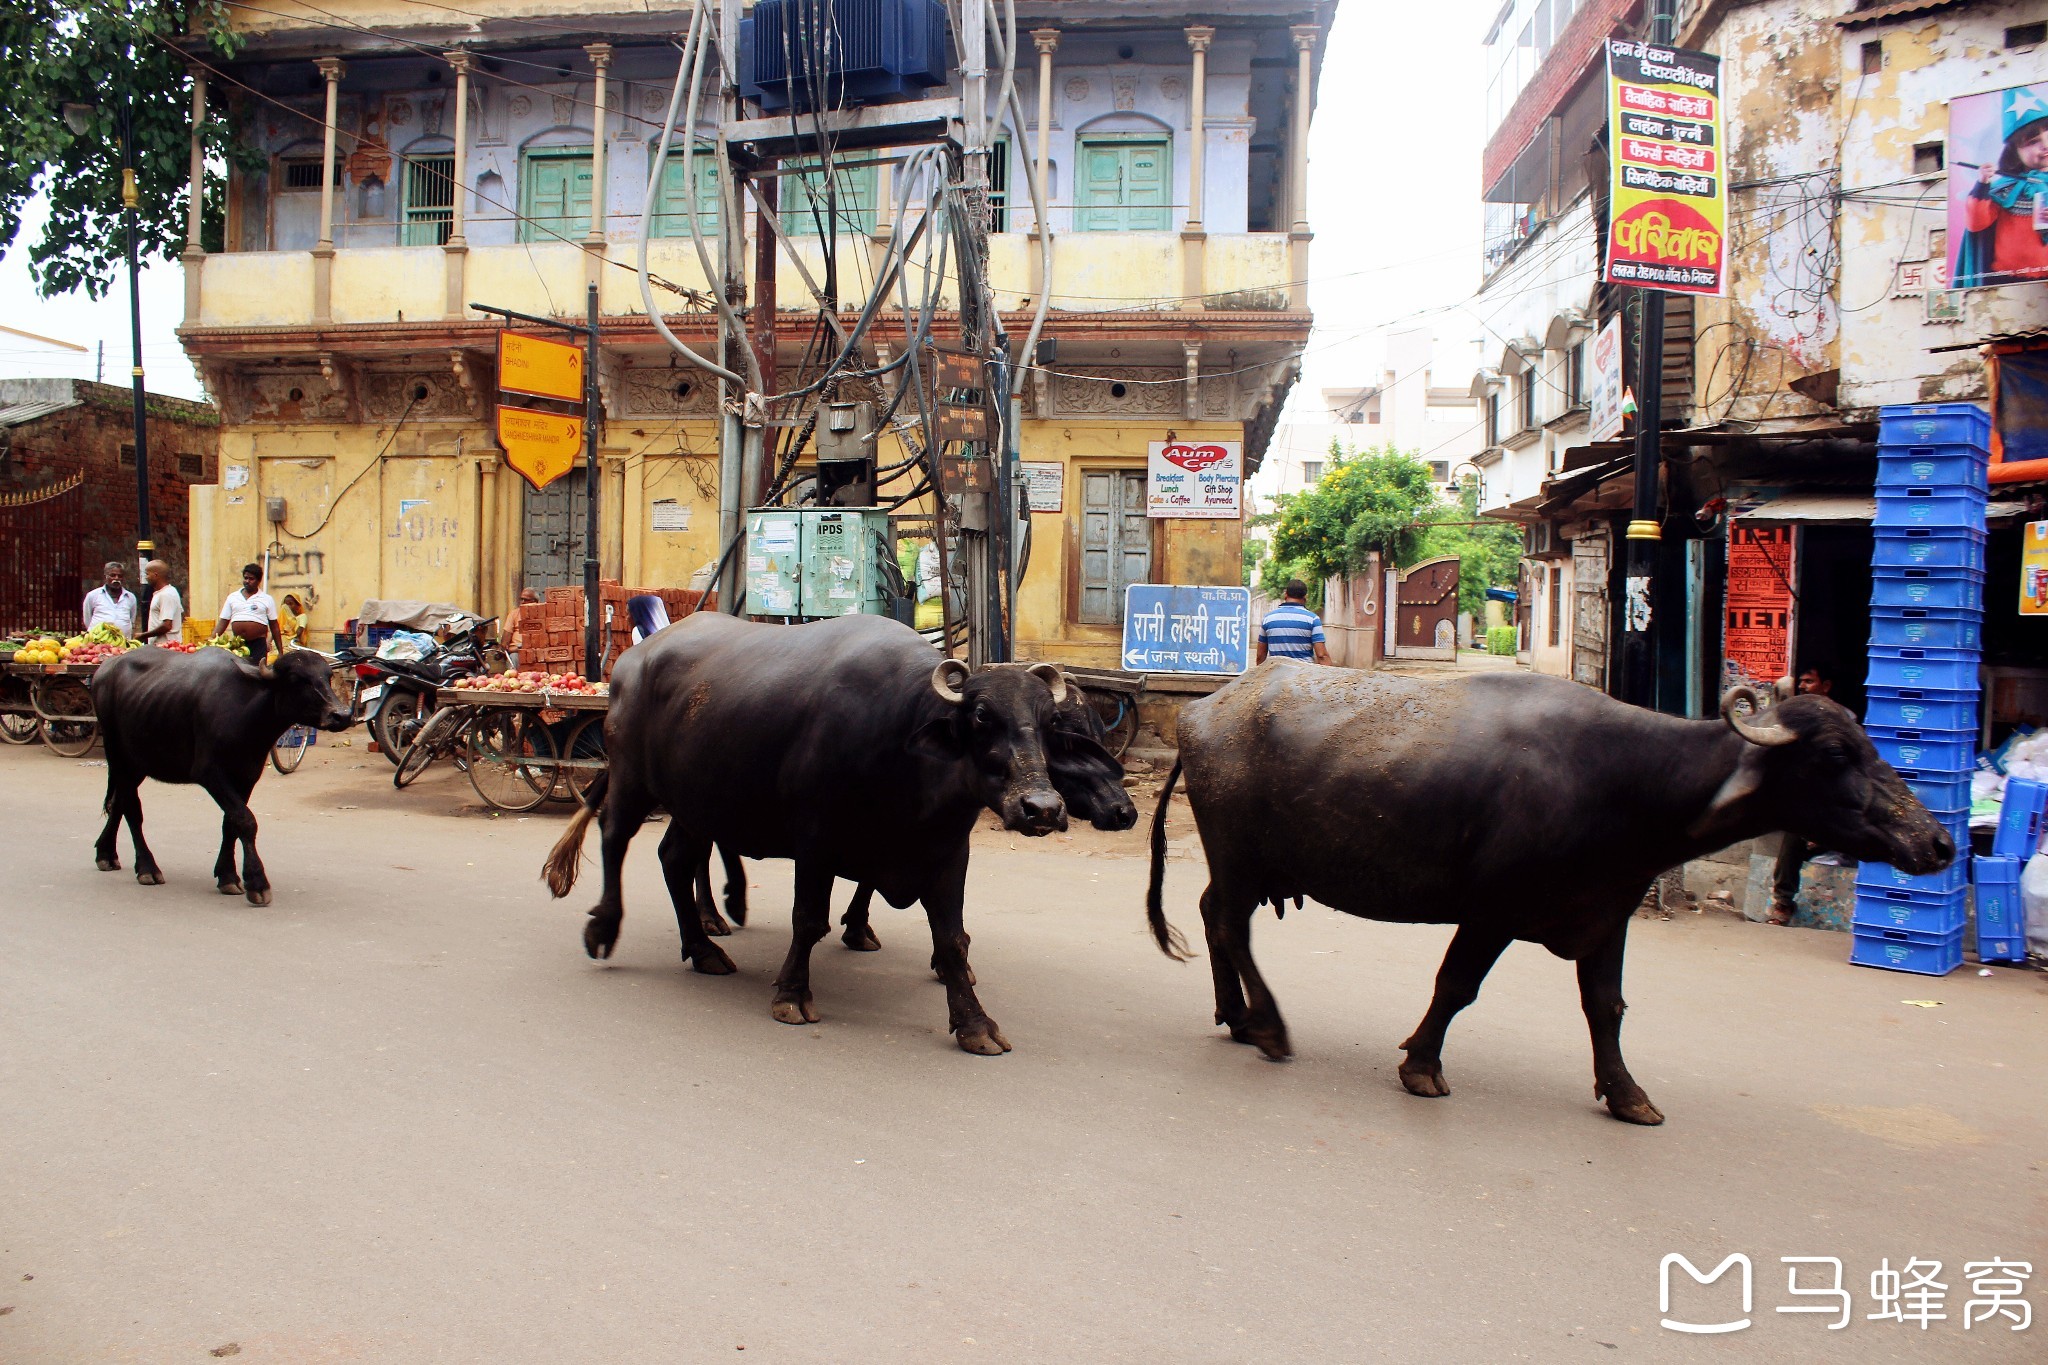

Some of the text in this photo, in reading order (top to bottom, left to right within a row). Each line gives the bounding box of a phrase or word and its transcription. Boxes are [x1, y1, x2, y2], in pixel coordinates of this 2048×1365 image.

[1611, 40, 1675, 64] दाम में कम
[1629, 118, 1665, 135] लहंगा
[1615, 211, 1719, 265] परिवार
[1166, 448, 1215, 458] Aum
[1183, 459, 1233, 470] Café
[1156, 473, 1185, 484] Breakfast
[1198, 473, 1239, 485] Body Piercing
[1160, 484, 1179, 493] Lunch
[1204, 484, 1233, 496] Gift Shop
[1149, 495, 1164, 503] Cake
[1170, 495, 1190, 506] Coffee
[1204, 495, 1233, 506] Ayurveda
[818, 524, 843, 535] IPDS
[1730, 608, 1786, 628] T.E.T.
[1133, 601, 1165, 643] रानी
[1171, 603, 1209, 644] लक्ष्मी
[1215, 605, 1242, 651] बाई
[1771, 637, 1785, 645] TGT
[1144, 648, 1179, 665] (जन्म
[1729, 651, 1785, 663] SSC/BANK/RLY
